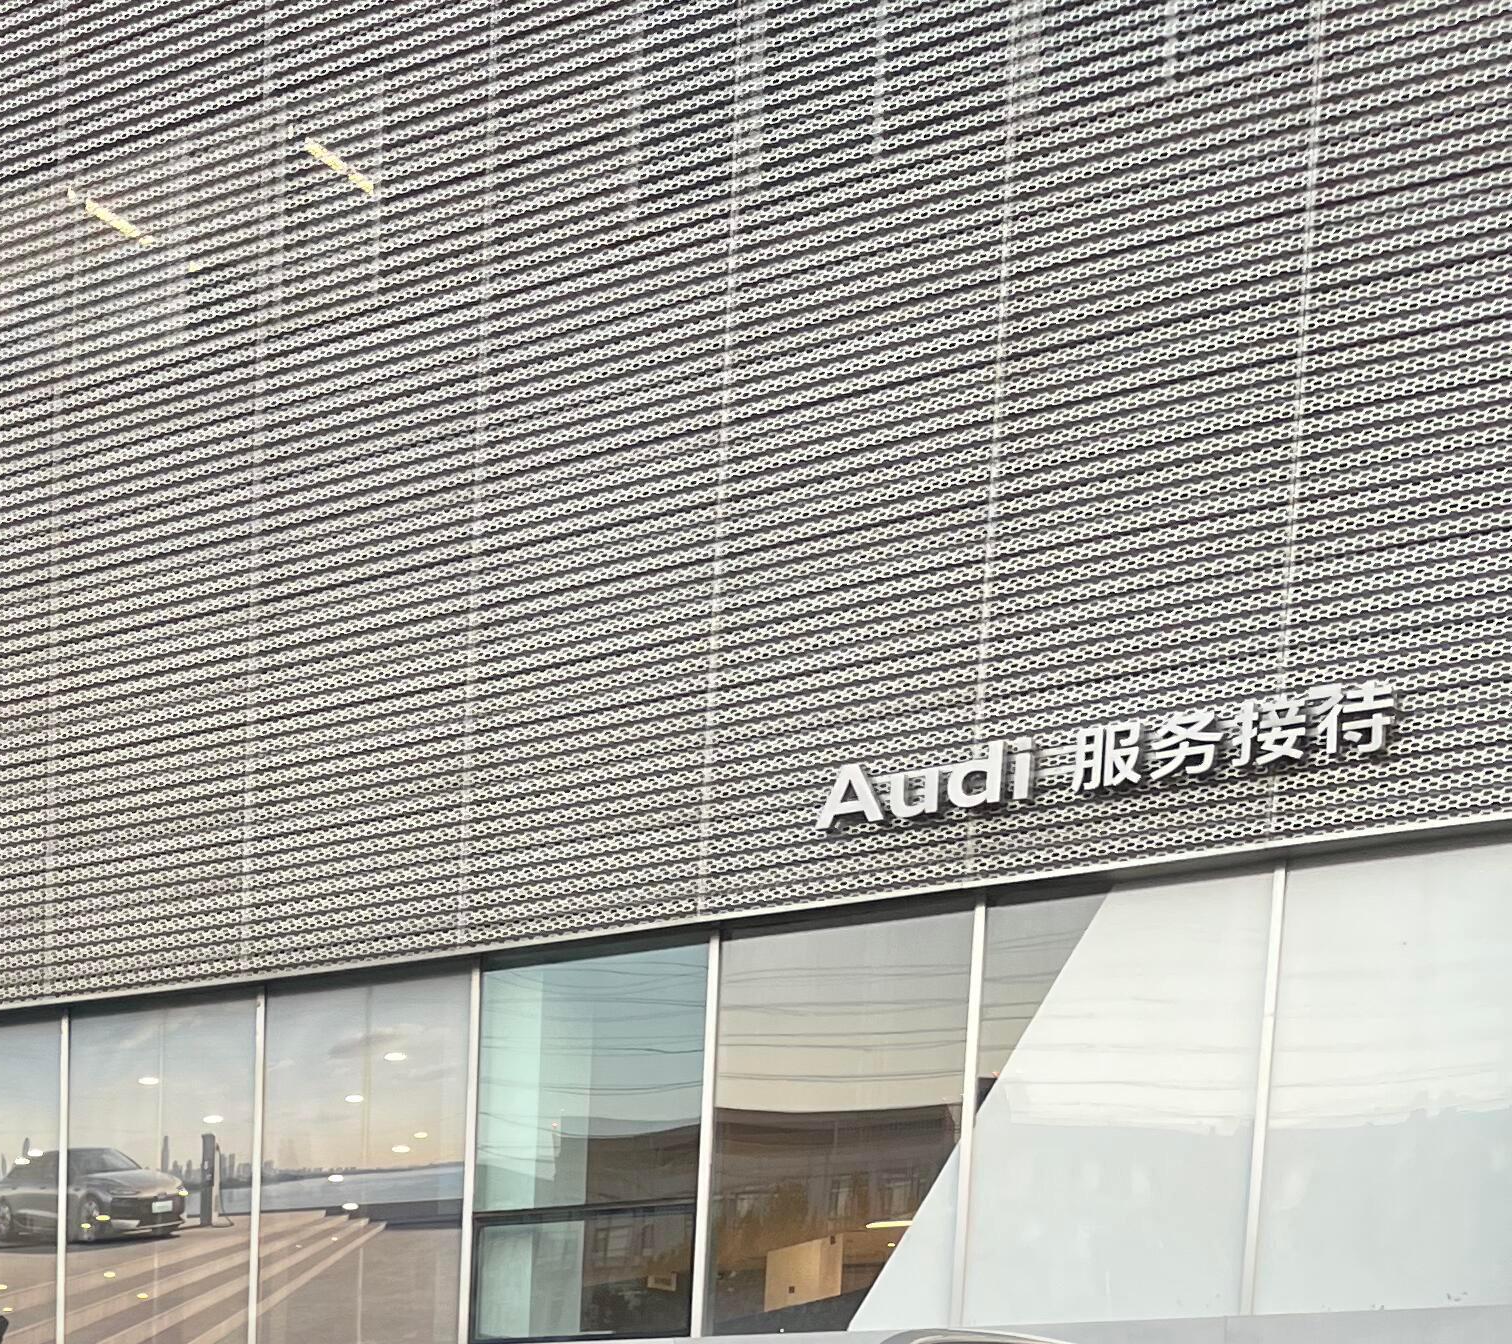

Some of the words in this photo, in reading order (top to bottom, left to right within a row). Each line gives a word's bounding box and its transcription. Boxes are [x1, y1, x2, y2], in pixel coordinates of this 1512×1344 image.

[815, 736, 1037, 831] Audi
[1070, 682, 1396, 793] 服务接待
